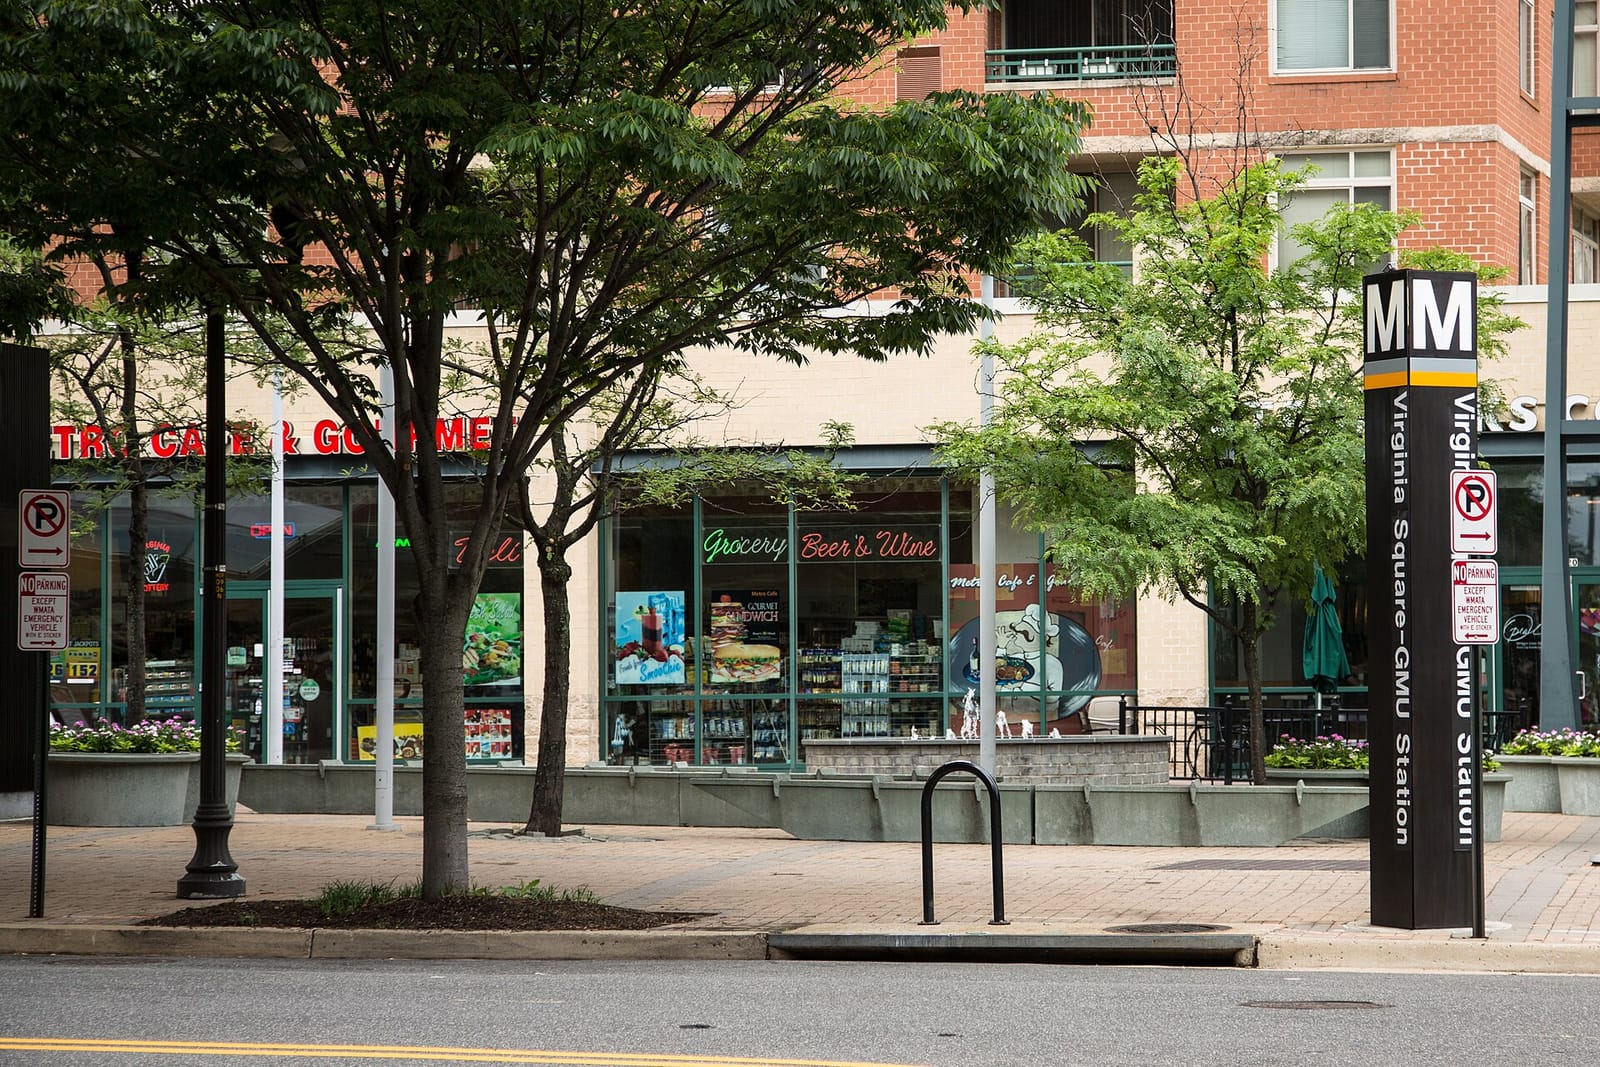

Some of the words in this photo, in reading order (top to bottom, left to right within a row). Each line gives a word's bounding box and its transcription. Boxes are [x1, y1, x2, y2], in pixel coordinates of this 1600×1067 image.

[1367, 280, 1405, 354] M
[1413, 279, 1473, 352] M
[151, 422, 254, 458] CAE
[1391, 391, 1408, 502] Virginia
[250, 525, 293, 537] OPN
[703, 528, 788, 563] Grocery
[801, 533, 851, 558] Beer
[855, 535, 872, 557] &
[876, 530, 936, 557] Wine
[1454, 565, 1467, 581] NO
[1467, 568, 1495, 579] PARKING
[21, 577, 35, 593] NO
[36, 580, 66, 591] PARKING
[143, 583, 169, 592] OTTERY
[1463, 586, 1487, 595] EXCEPT
[31, 597, 57, 606] EXCEPT
[1465, 596, 1486, 604] WMATA
[726, 611, 779, 622] SANDWICH
[1457, 605, 1494, 614] EMERGENCY
[24, 615, 63, 623] EMERGENCY
[1391, 519, 1410, 718] Square-GMU
[1463, 615, 1489, 624] VEHICLE
[30, 624, 58, 632] VEHICLE
[1396, 733, 1411, 845] Station
